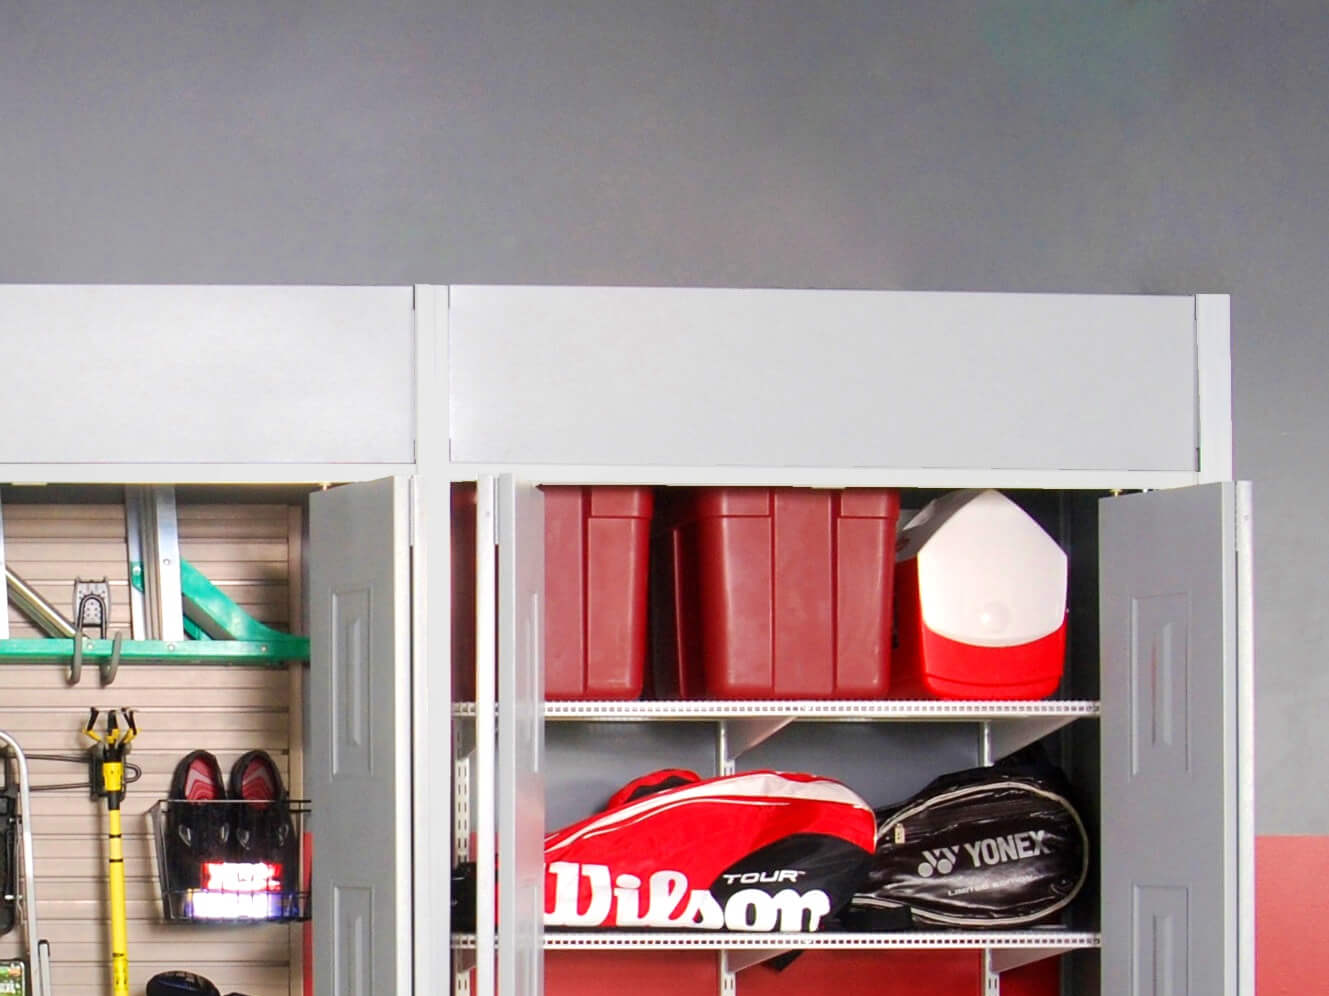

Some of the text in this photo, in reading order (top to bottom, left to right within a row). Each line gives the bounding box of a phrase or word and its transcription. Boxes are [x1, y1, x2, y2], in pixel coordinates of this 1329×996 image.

[964, 829, 1051, 868] YONEX
[544, 861, 831, 932] Wilson
[723, 869, 799, 885] TOUR
